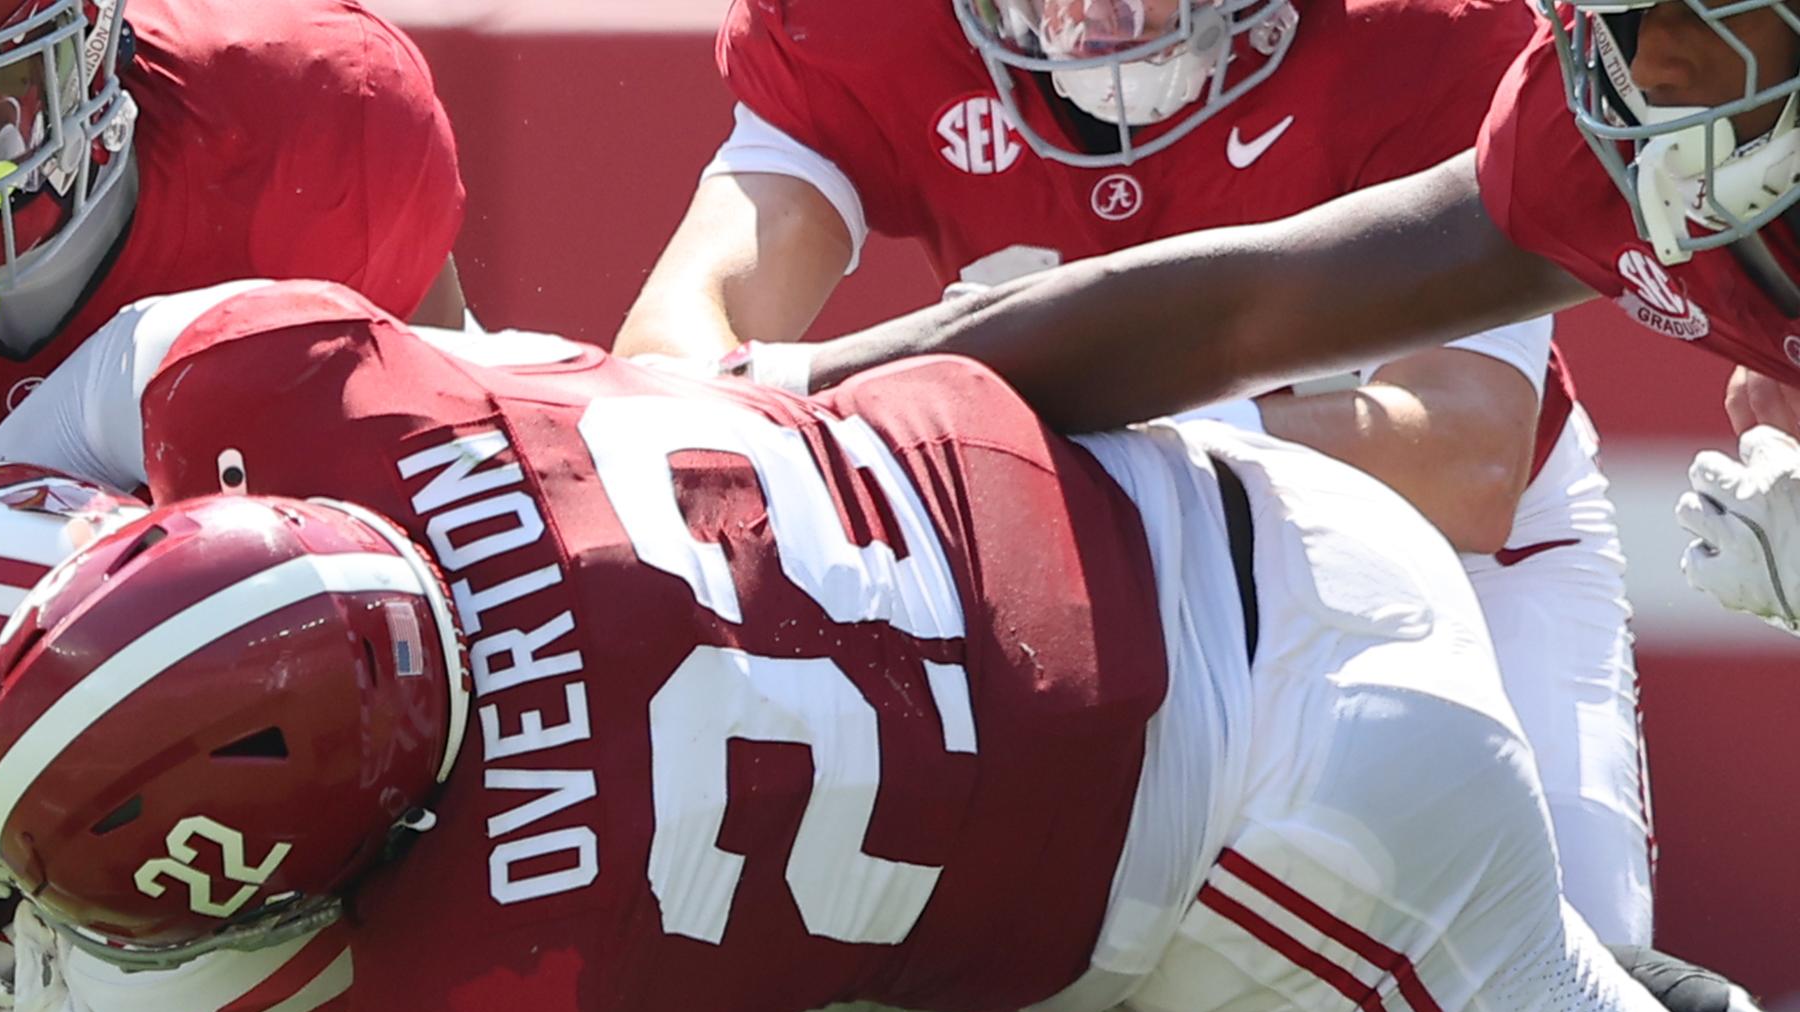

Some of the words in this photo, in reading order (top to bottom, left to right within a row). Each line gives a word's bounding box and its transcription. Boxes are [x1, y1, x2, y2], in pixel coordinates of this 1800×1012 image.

[1608, 57, 1633, 98] TIDE
[936, 97, 1022, 174] SEC
[1618, 250, 1687, 315] SEC
[398, 429, 599, 905] OVERTON
[578, 395, 979, 945] 22
[133, 815, 293, 919] 22
